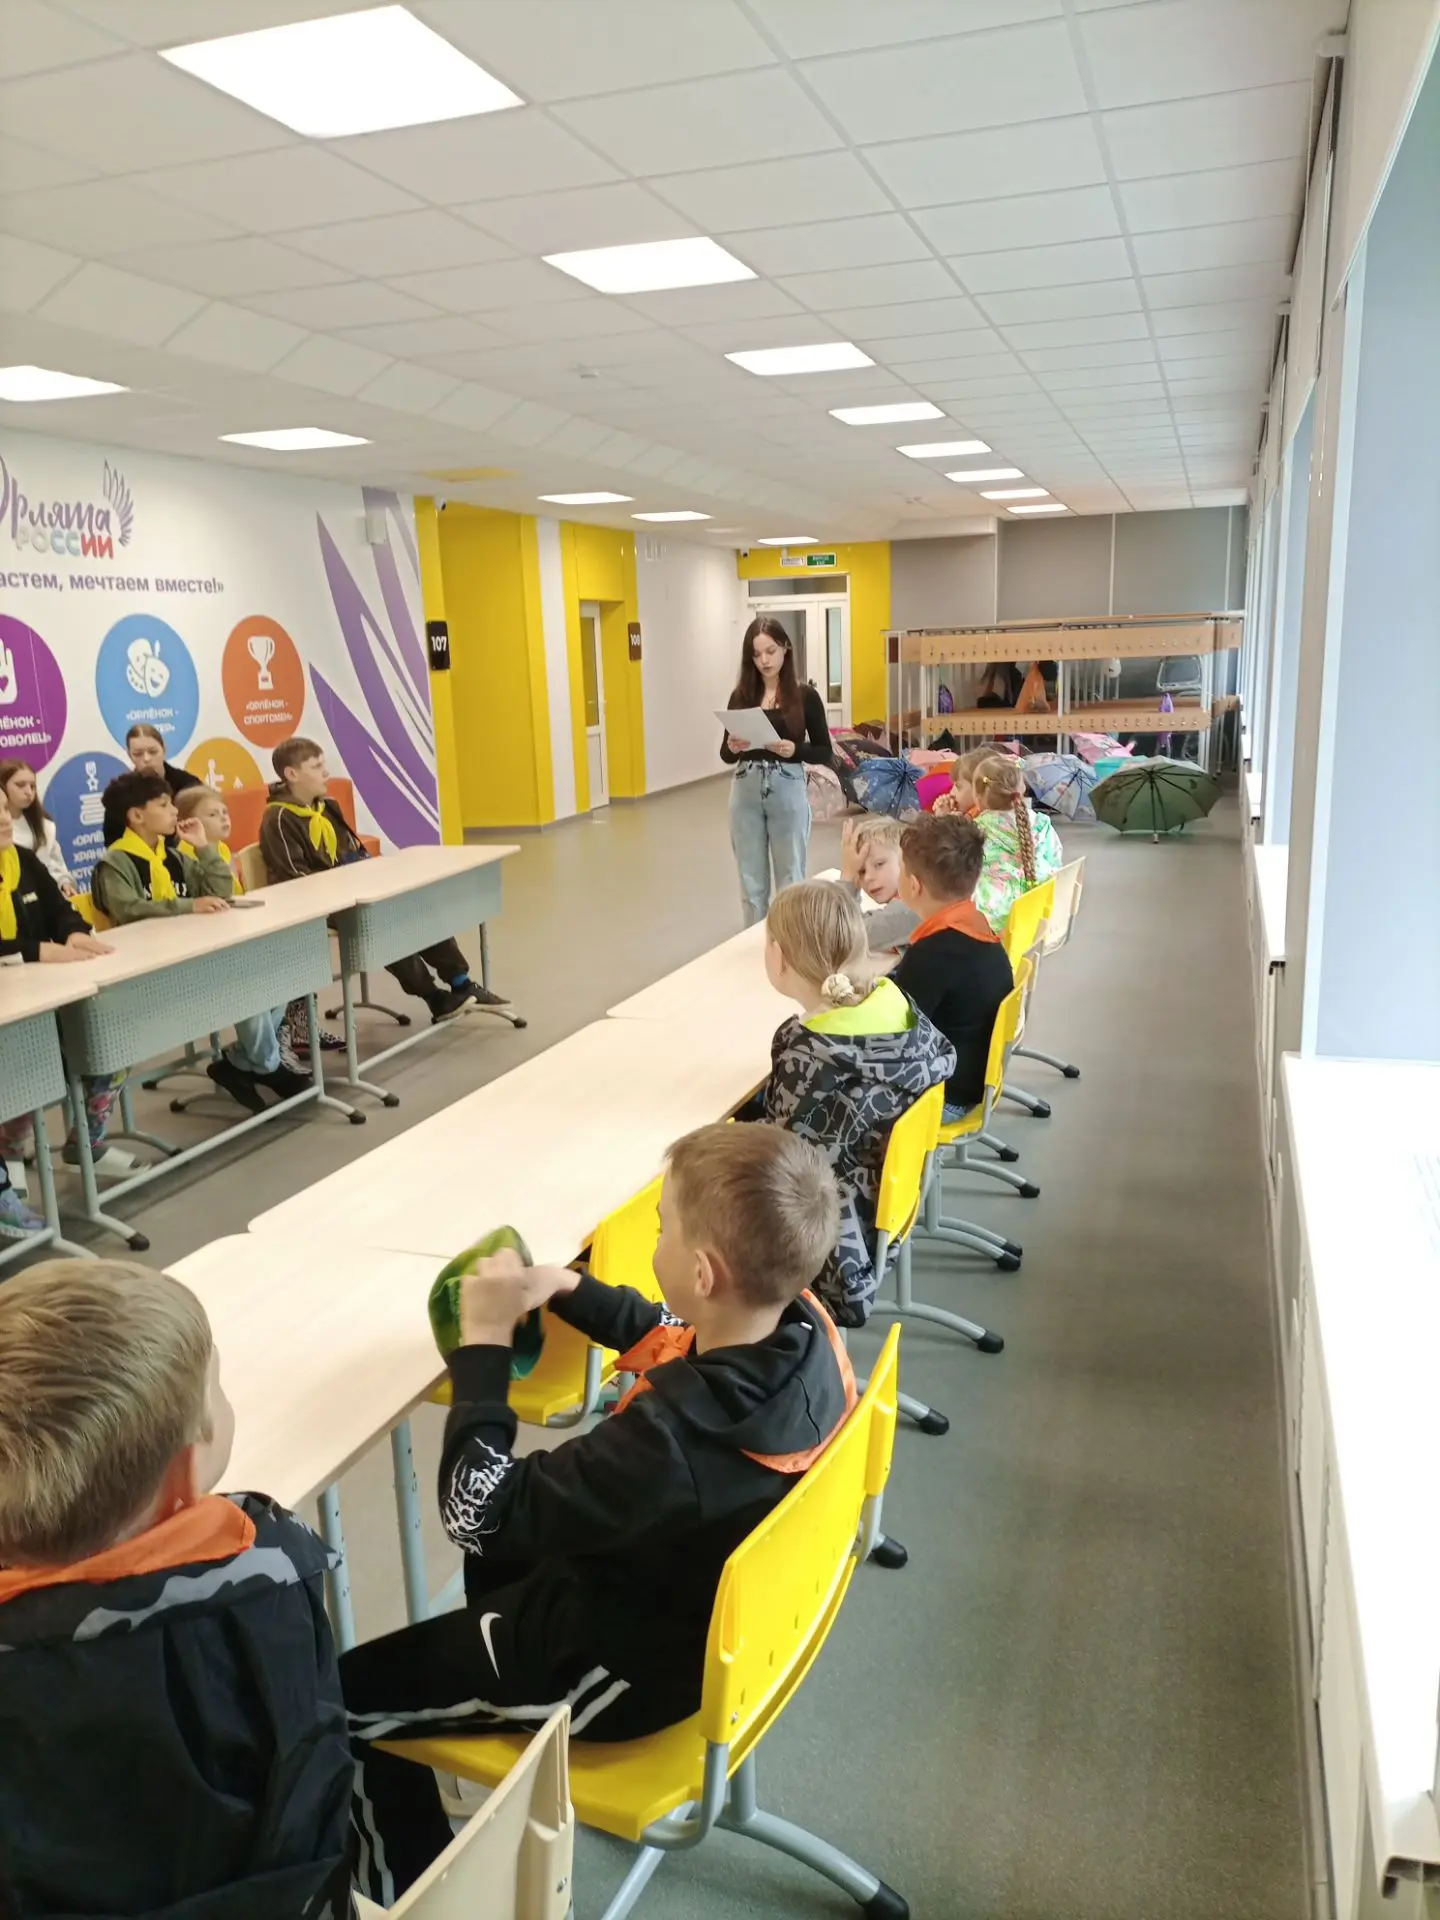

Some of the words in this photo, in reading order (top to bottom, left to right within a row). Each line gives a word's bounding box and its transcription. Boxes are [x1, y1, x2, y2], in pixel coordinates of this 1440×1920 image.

[15, 525, 114, 560] РОССИИ
[69, 574, 150, 592] мечтаем
[155, 577, 224, 594] вместе!»
[431, 635, 448, 652] 107
[243, 712, 293, 726] СПОРТСМЕН»
